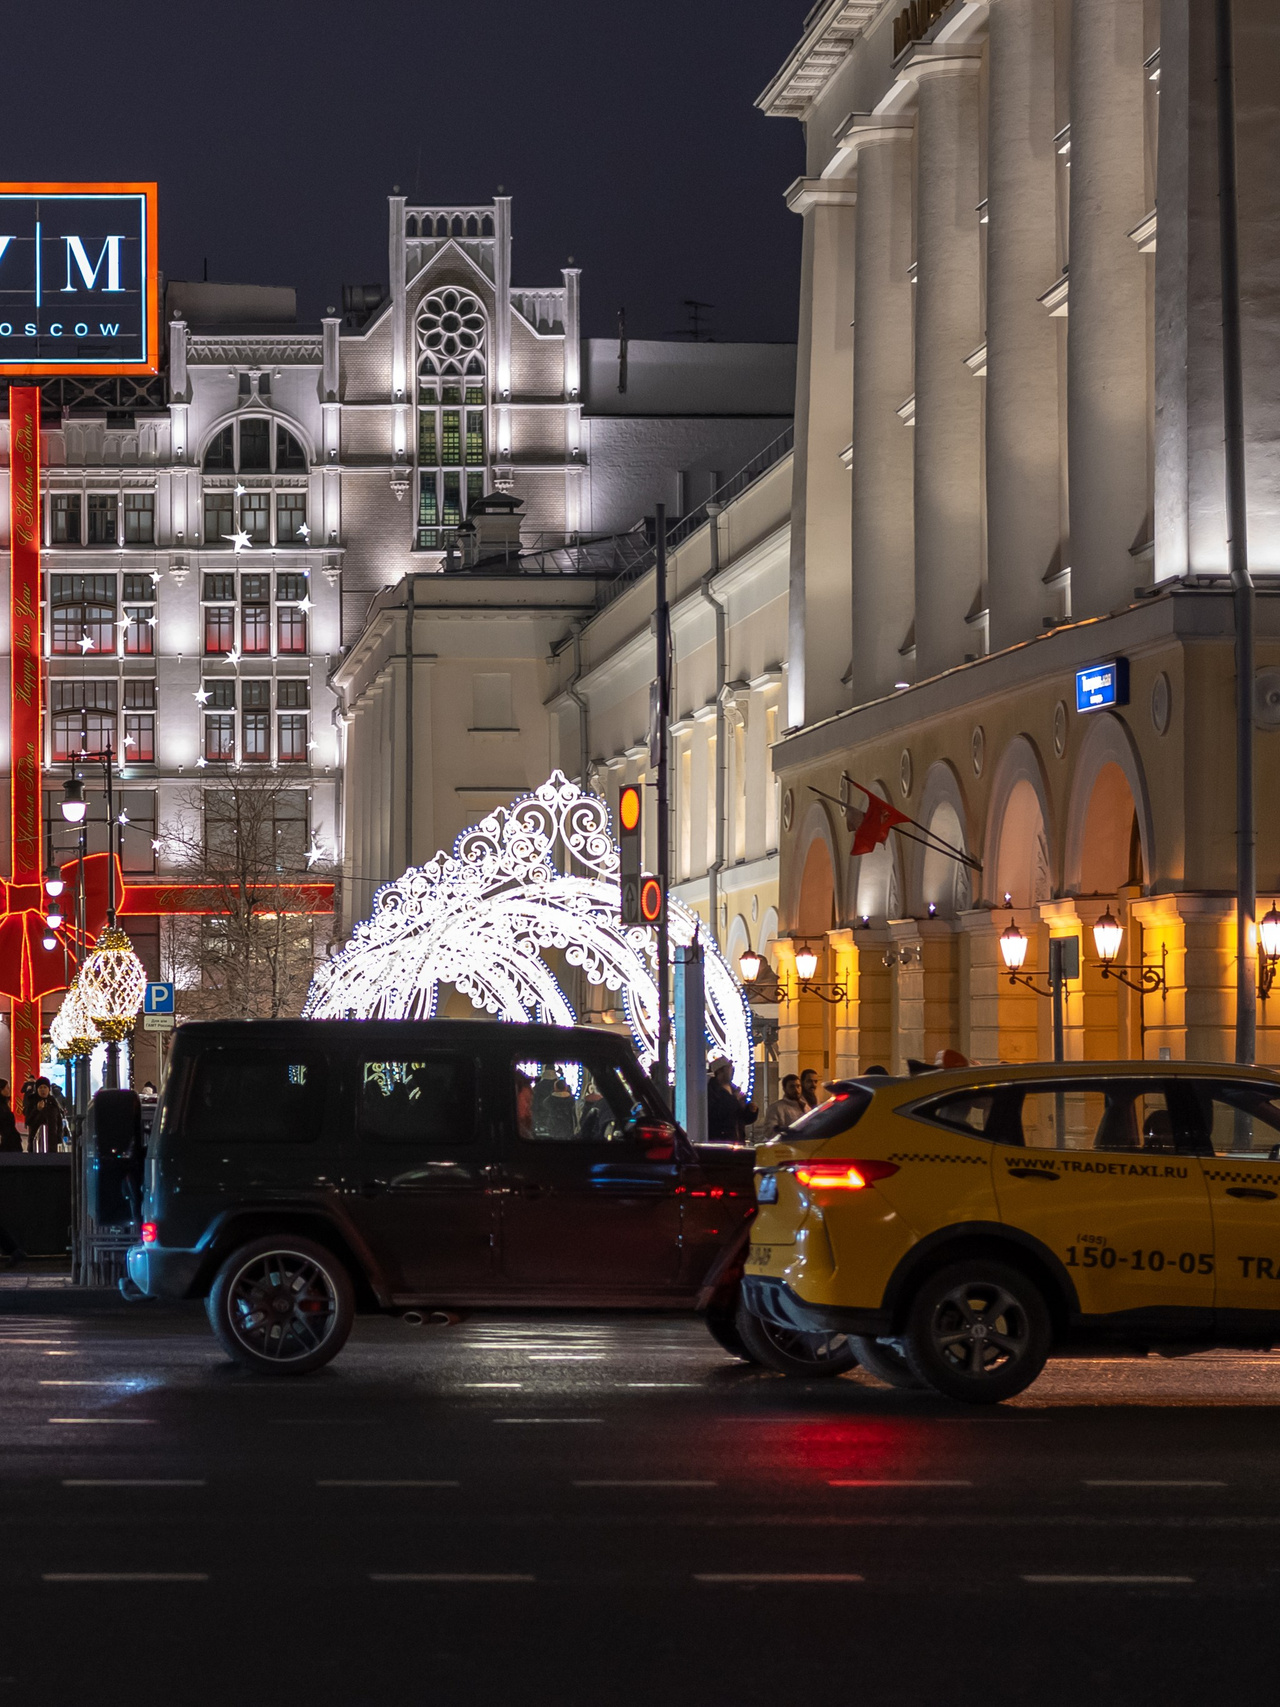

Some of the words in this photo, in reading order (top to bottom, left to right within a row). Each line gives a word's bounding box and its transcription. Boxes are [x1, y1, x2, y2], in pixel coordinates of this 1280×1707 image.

[15, 413, 34, 463] Годом
[16, 465, 35, 527] Новым
[14, 582, 36, 620] Year
[14, 623, 32, 657] New
[15, 656, 37, 707] Happy
[17, 742, 35, 791] Годом
[151, 985, 169, 1010] P
[15, 1038, 32, 1071] New
[1004, 1156, 1188, 1179] WWW.TRADETAXI.RU
[1076, 1233, 1107, 1247] (495)
[1065, 1245, 1215, 1276] 150-10-05
